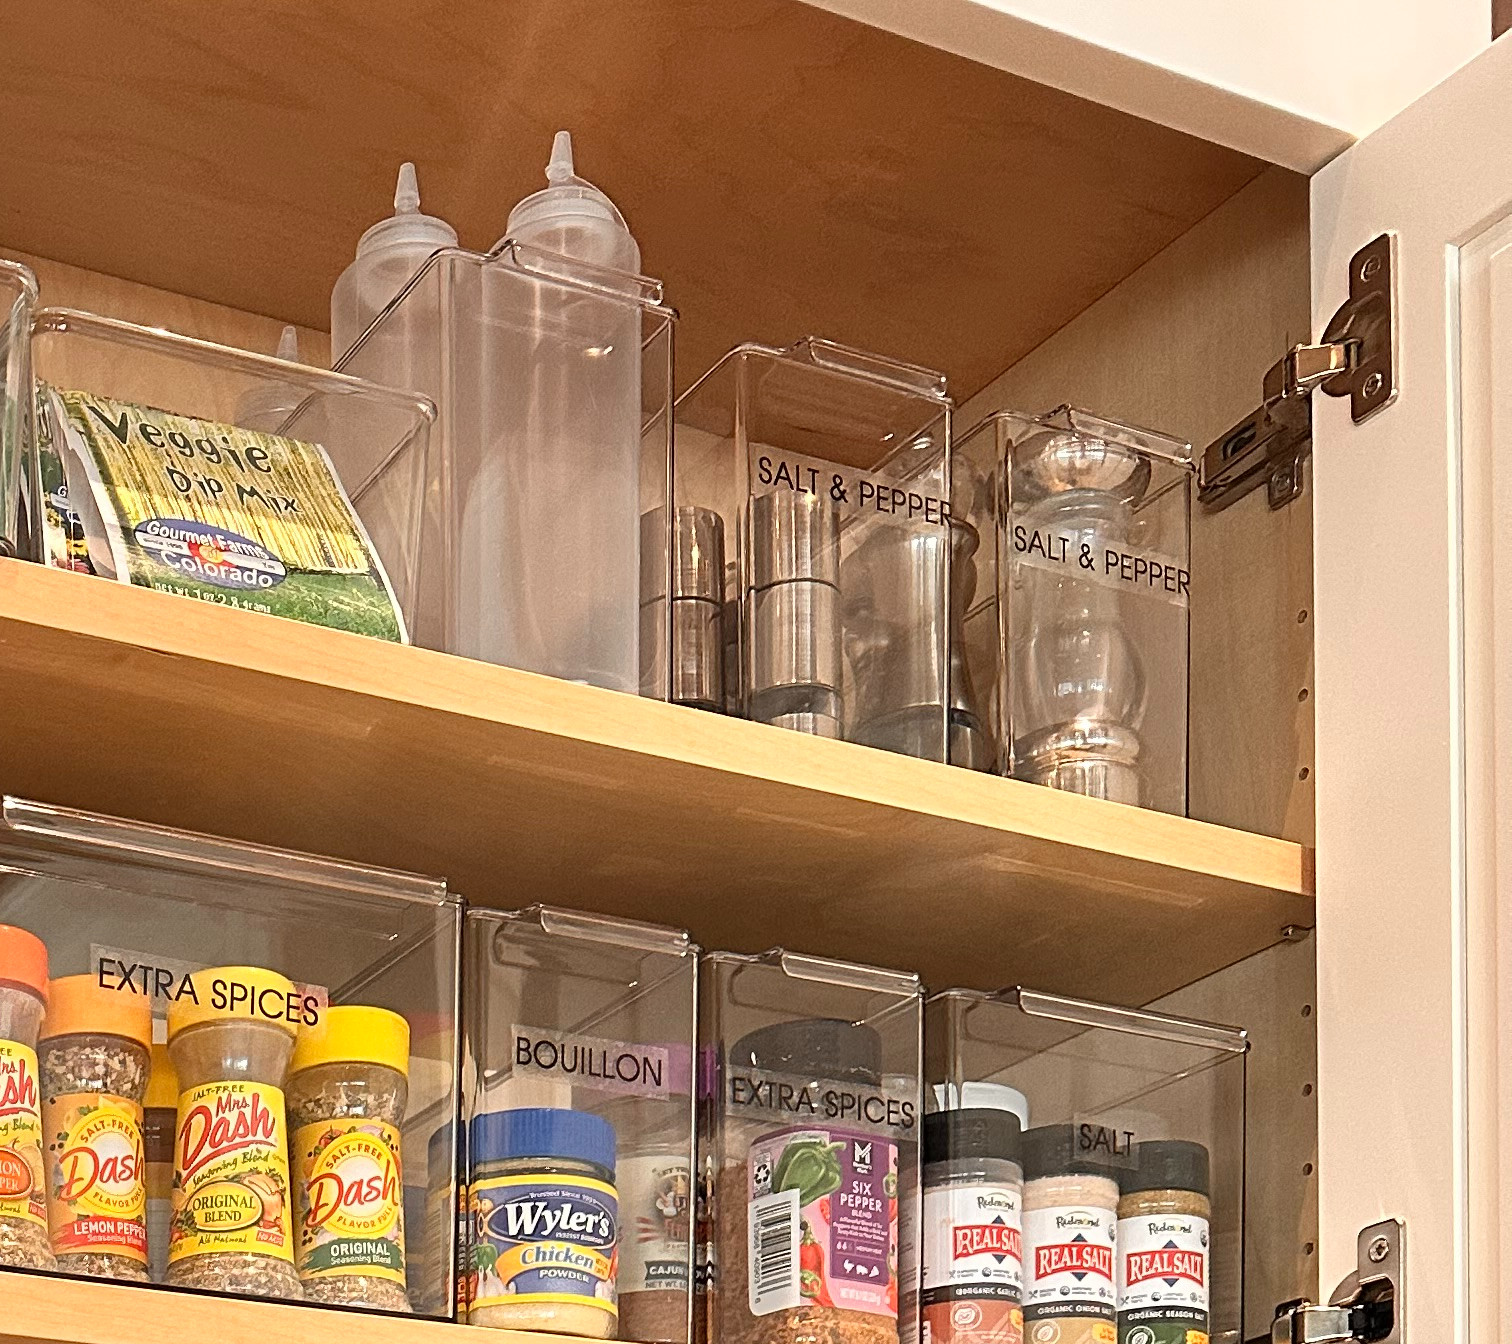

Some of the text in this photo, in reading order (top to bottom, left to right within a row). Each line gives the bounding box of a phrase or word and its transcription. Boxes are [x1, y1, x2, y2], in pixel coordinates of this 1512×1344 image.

[89, 406, 270, 473] Veggie
[166, 464, 302, 514] Dip Mix
[758, 456, 951, 528] SALT & PEPPER
[146, 520, 269, 561] Gourmet Farms
[160, 551, 273, 588] Colorado
[1014, 525, 1190, 596] SALT & PEPPER
[99, 958, 319, 1027] EXTRA SPICES
[515, 1037, 662, 1087] BOUILLON
[732, 1077, 915, 1129] EXTRA SPICES
[180, 1096, 274, 1170] Dash
[1079, 1124, 1134, 1156] SALT
[192, 1195, 256, 1212] ORIGINAL
[307, 1171, 398, 1225] Dash
[840, 1193, 882, 1213] PEPPER
[852, 1181, 872, 1194] SIX
[73, 1222, 111, 1235] LEMON
[204, 1208, 242, 1223] BLEND
[505, 1202, 610, 1239] Wyler's
[330, 1244, 390, 1257] ORIGINAL
[520, 1247, 593, 1269] Chicken
[539, 1269, 589, 1283] POWDER
